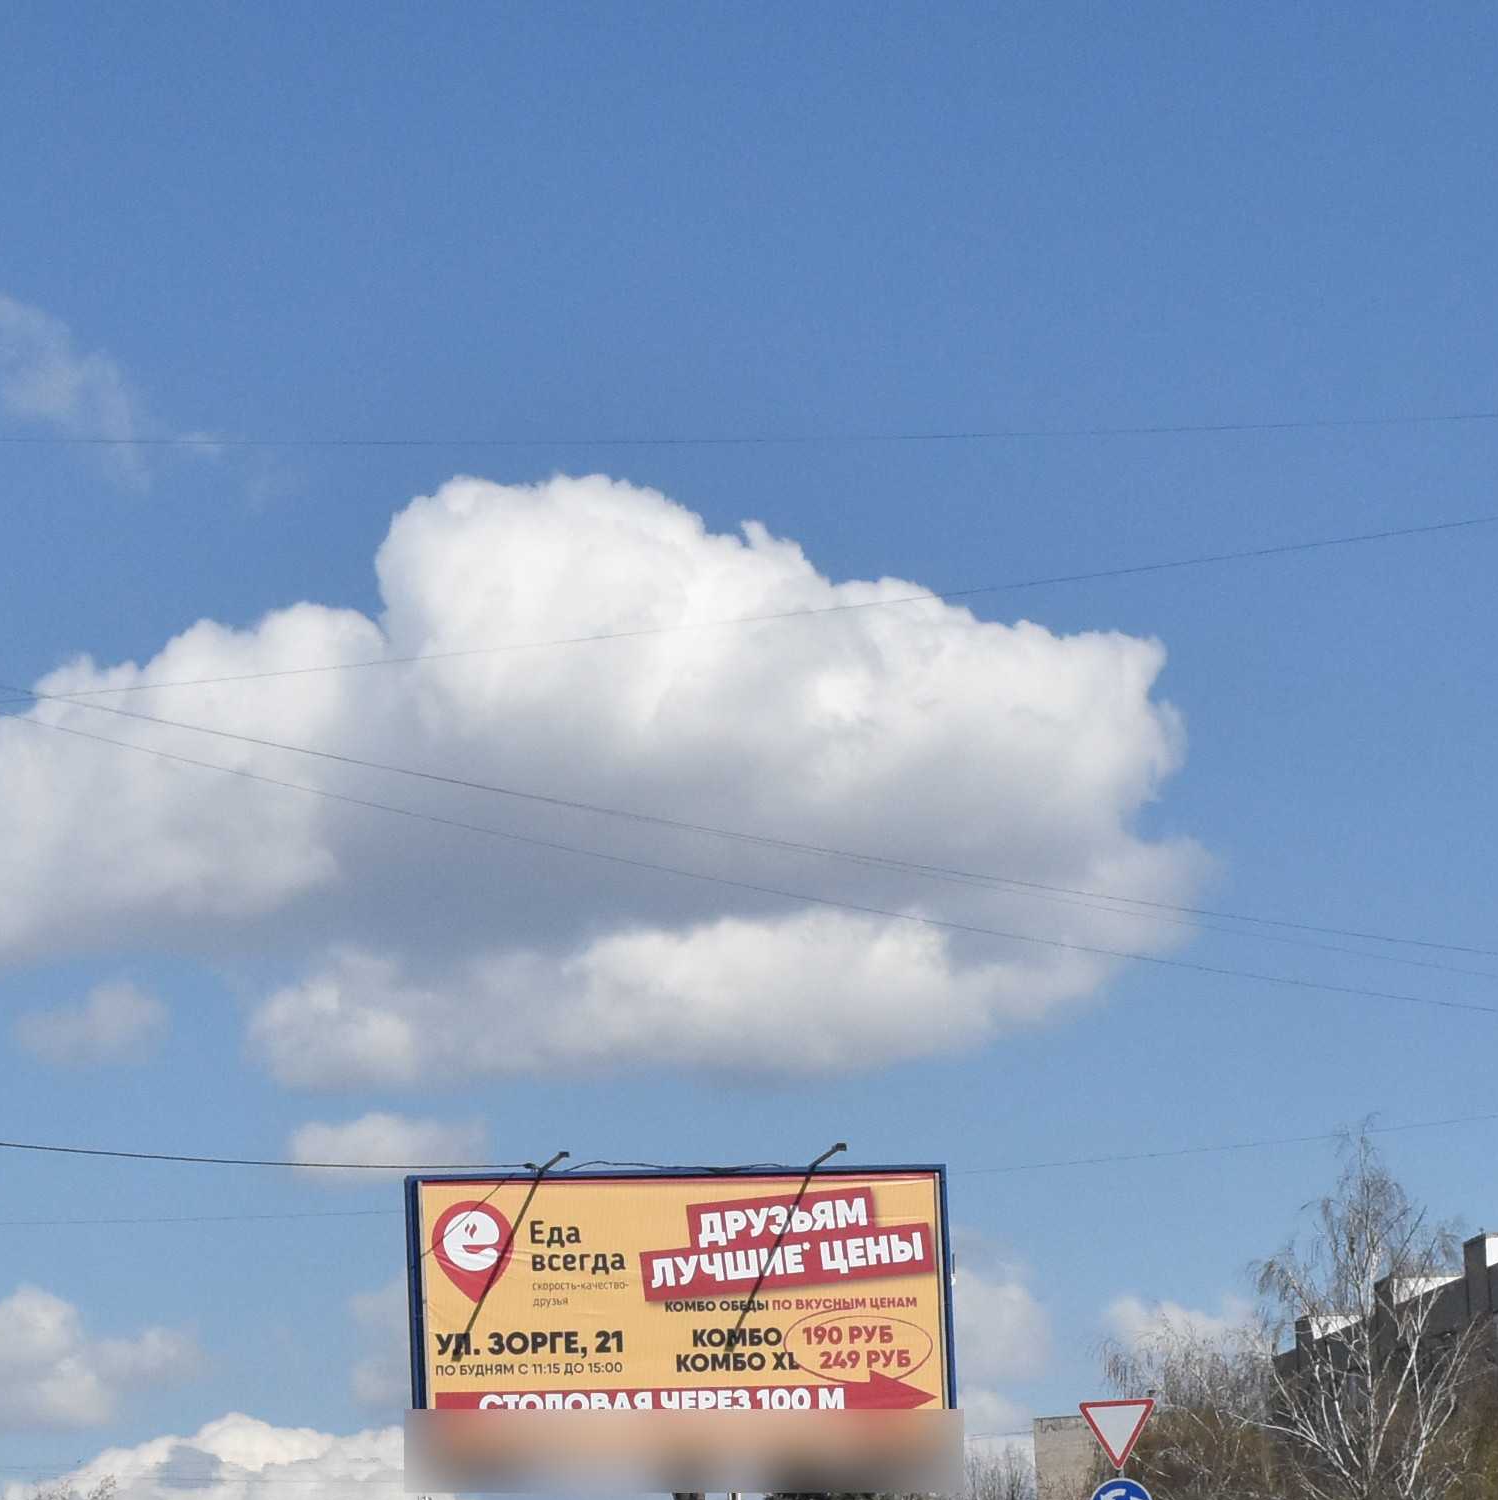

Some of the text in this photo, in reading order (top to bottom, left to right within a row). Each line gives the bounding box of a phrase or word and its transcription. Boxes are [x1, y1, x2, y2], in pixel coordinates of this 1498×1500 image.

[530, 1220, 581, 1248] Еда
[698, 1198, 868, 1248] ДРУЗЬЯМ
[532, 1252, 626, 1275] всегда
[820, 1232, 924, 1274] ЦЕНЫ
[532, 1296, 569, 1307] друзья
[665, 1297, 917, 1313] КОМБО ОБЕДЫ ПО ВКУСНЫМ ЦЕНАМ
[435, 1330, 623, 1358] УЛ. ЗОРГЕ, 21
[692, 1325, 893, 1348] КОМБО 190 РУБ
[435, 1361, 623, 1378] ПО БУДНЯМ С 11:15 ДО 15:00
[676, 1352, 766, 1372] КОМБО
[819, 1350, 861, 1370] 249
[866, 1350, 911, 1369] РУБ
[660, 1389, 752, 1410] ЧЕРЕЗ
[756, 1388, 811, 1410] 100
[819, 1387, 845, 1410] М
